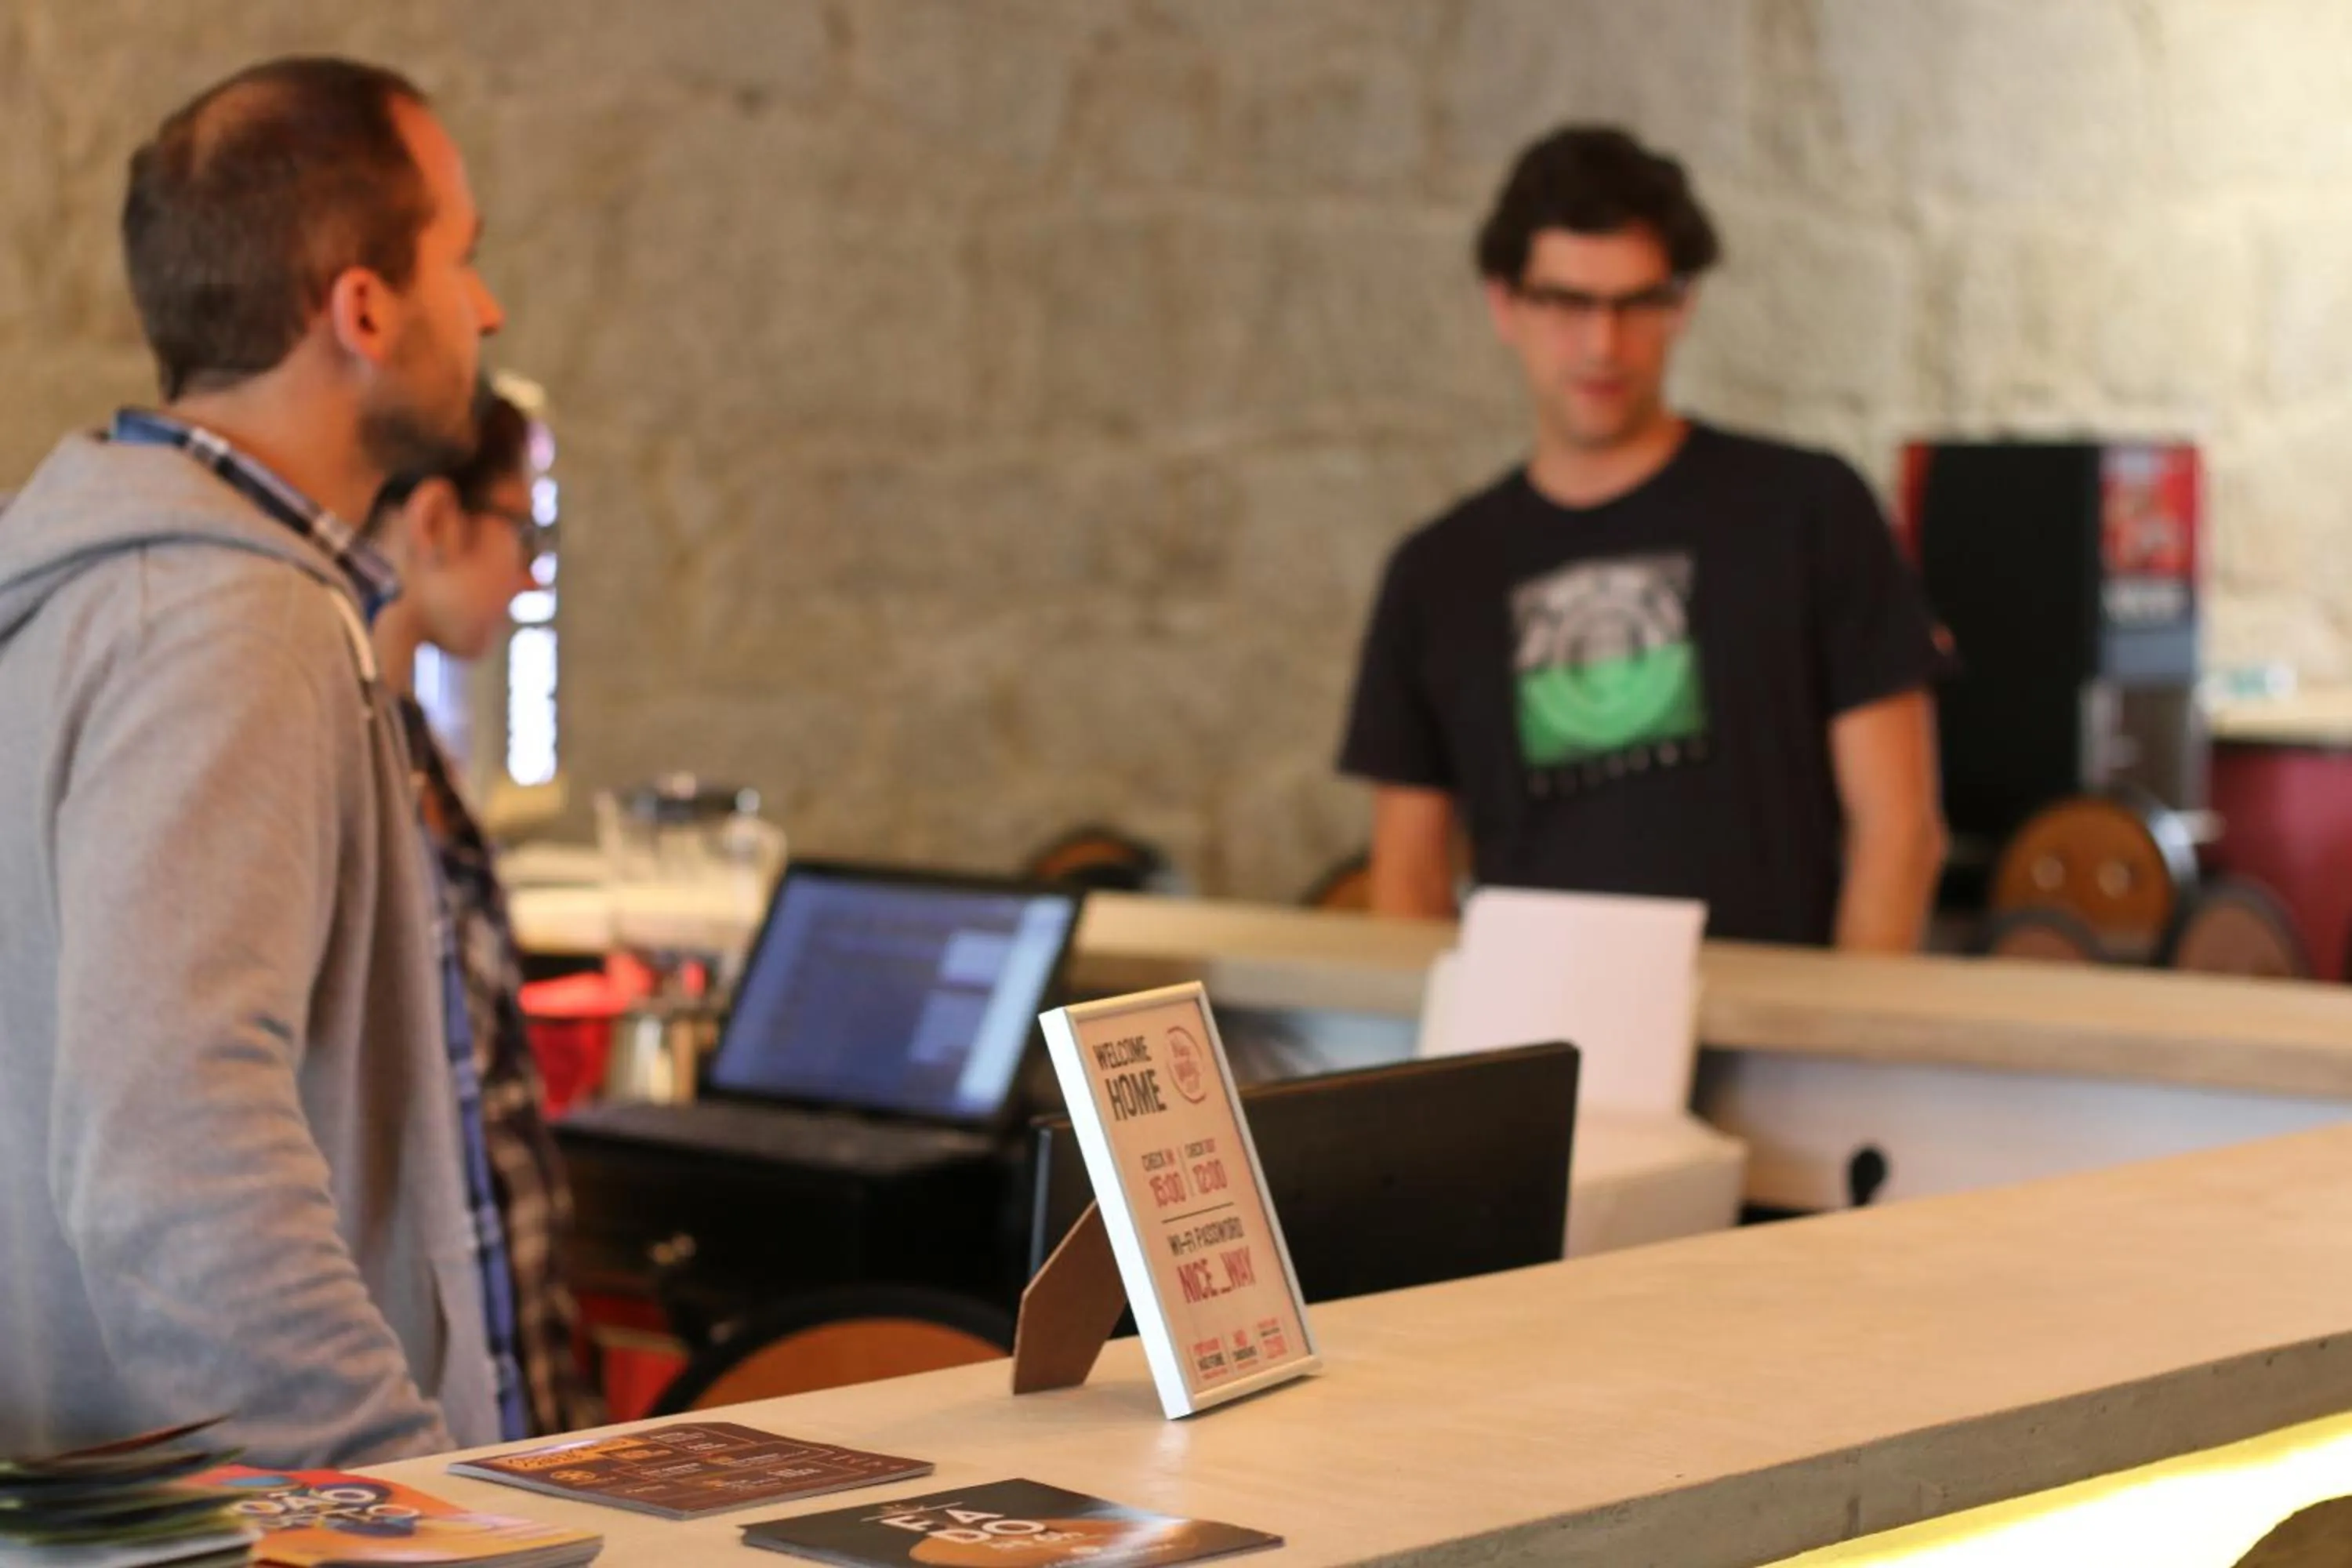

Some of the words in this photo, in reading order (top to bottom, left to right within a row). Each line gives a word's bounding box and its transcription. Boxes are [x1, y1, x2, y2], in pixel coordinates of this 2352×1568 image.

[1092, 1035, 1152, 1070] WELCOME
[1105, 1069, 1167, 1121] HOME
[1149, 1171, 1186, 1208] 15:00
[1192, 1159, 1228, 1194] 12:00
[1167, 1229, 1197, 1257] WI-FI
[1193, 1217, 1244, 1248] PASSWORD
